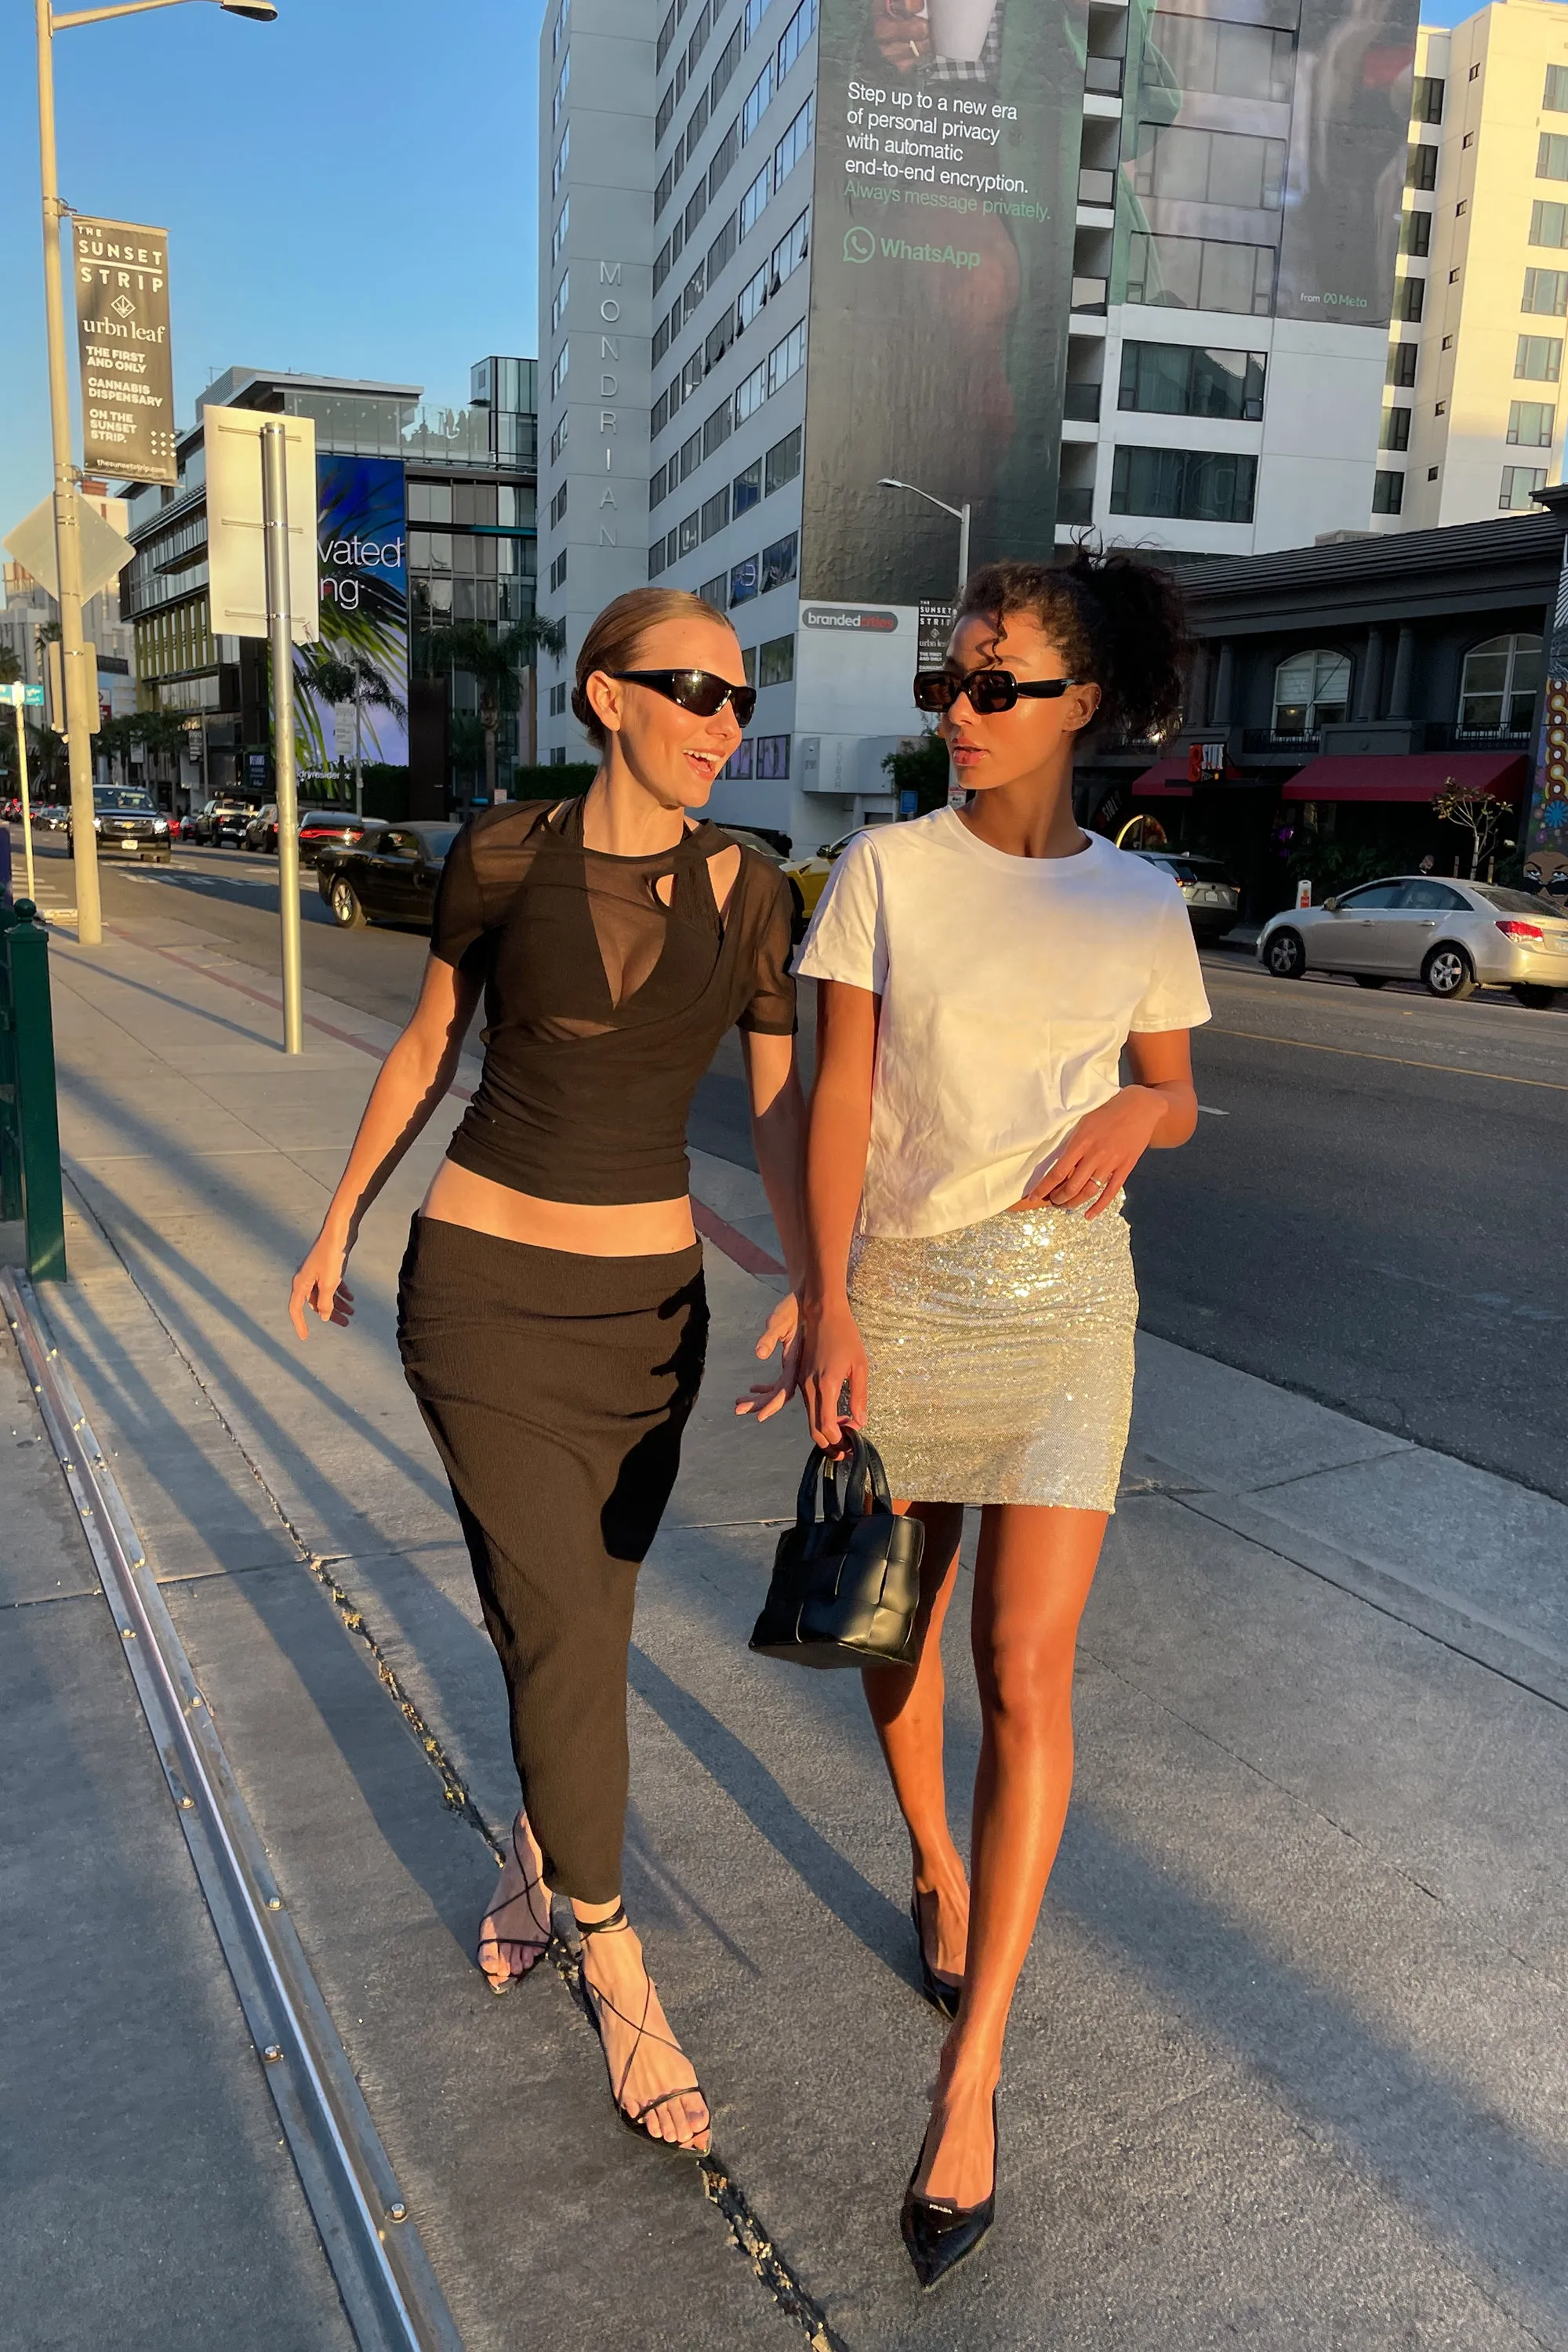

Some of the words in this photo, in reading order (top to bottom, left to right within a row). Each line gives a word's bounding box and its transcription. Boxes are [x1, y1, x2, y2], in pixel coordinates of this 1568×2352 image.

[848, 82, 886, 106] Step
[891, 92, 912, 110] up
[916, 91, 932, 109] to
[938, 97, 948, 111] a
[953, 99, 987, 116] new
[992, 103, 1018, 120] era
[847, 107, 864, 125] of
[868, 113, 937, 134] personal
[942, 121, 1000, 146] privacy
[846, 132, 879, 151] with
[884, 138, 964, 162] automatic
[845, 158, 935, 183] end-to-end
[940, 170, 1029, 194] encryption.
[844, 180, 900, 204] Always
[905, 189, 978, 214] message
[983, 198, 1051, 223] privately.
[78, 226, 102, 238] THE
[78, 239, 163, 266] SUNSET
[880, 238, 981, 270] WhatsApp
[81, 267, 163, 293] STRIP
[1300, 292, 1321, 303] from
[1338, 294, 1367, 308] Meta
[82, 316, 128, 338] urbn
[130, 320, 166, 343] leaf
[85, 345, 110, 358] THE
[112, 349, 146, 363] FIRST
[87, 356, 114, 368] AND
[114, 361, 147, 374] ONLY
[88, 376, 151, 395] CANNABIS
[88, 387, 163, 408] DISPENSARY
[89, 408, 107, 420] ON
[110, 411, 134, 423] THE
[600, 260, 622, 547] MONDRIAN
[90, 419, 137, 434] SUNSET
[90, 429, 127, 444] STRIP.
[318, 535, 402, 568] vated
[321, 576, 360, 610] ng
